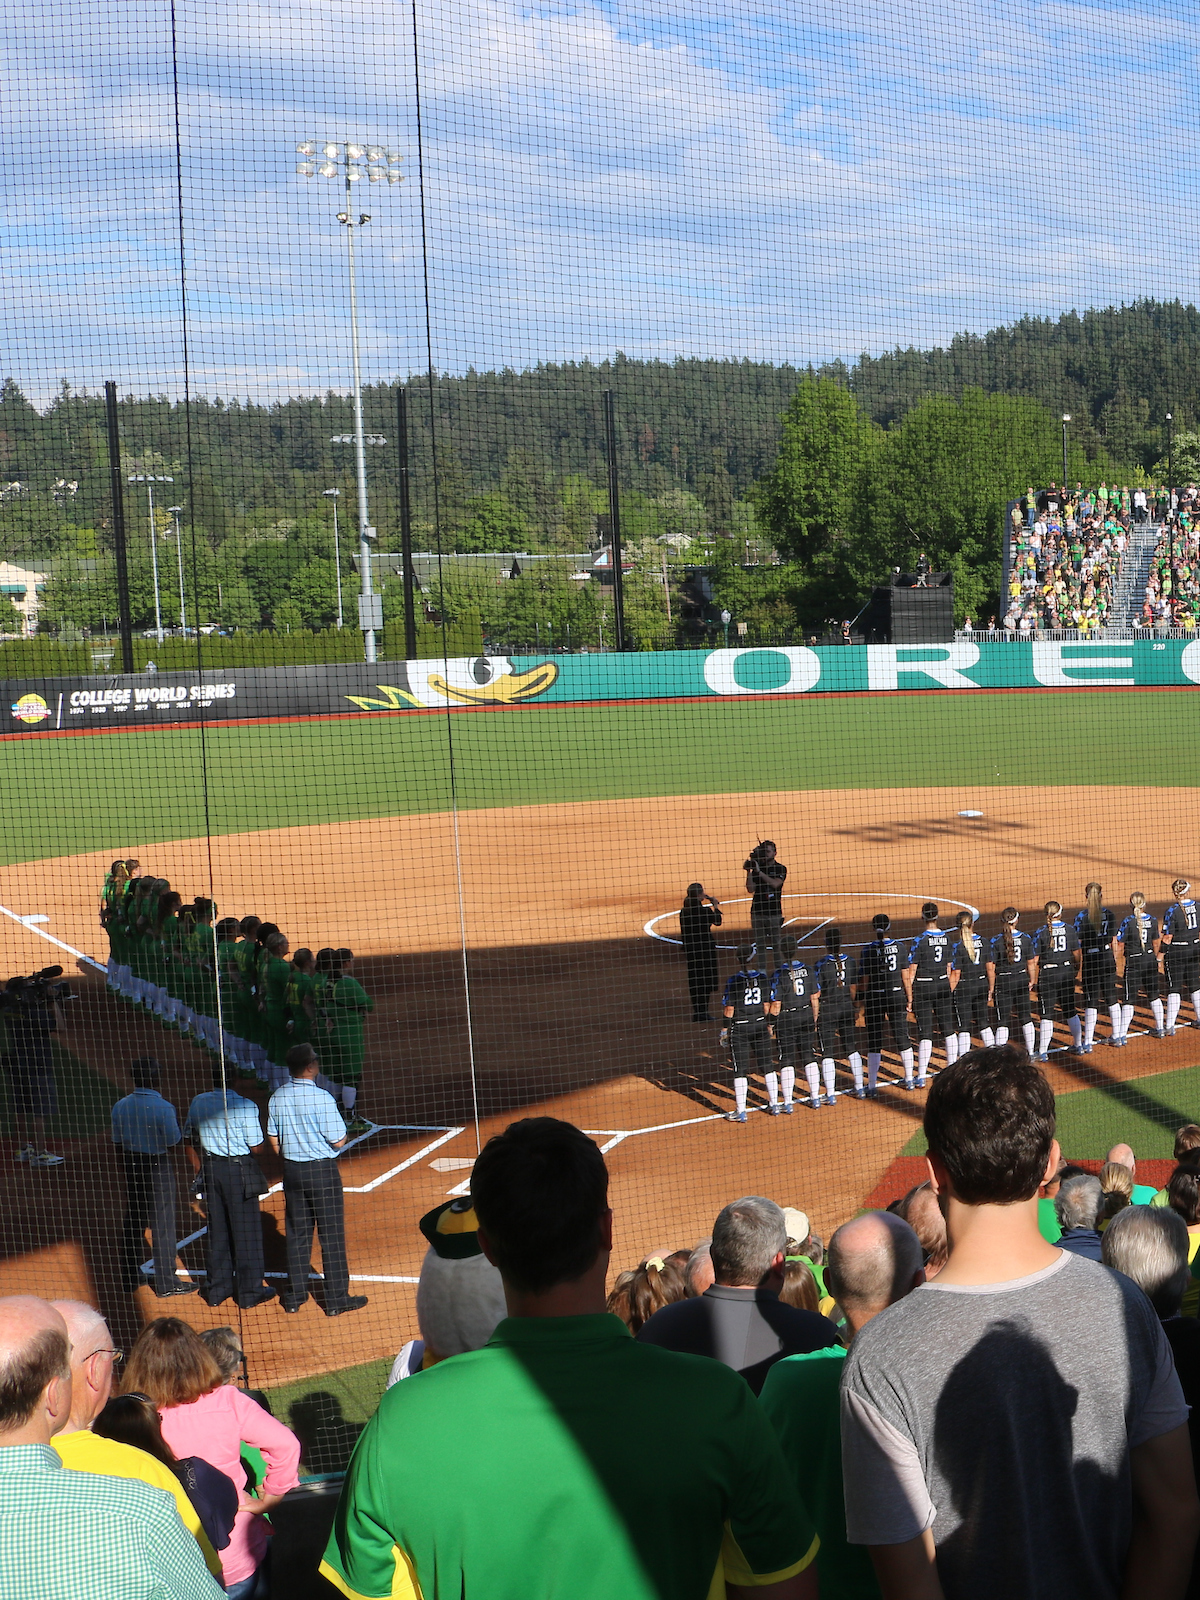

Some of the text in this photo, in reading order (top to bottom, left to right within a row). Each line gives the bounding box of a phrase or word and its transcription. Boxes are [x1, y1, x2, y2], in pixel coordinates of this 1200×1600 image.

[1152, 643, 1166, 651] 220
[70, 683, 236, 707] COLLEGE WORLD SERIES
[1187, 913, 1198, 929] 11
[1053, 936, 1067, 952] 19
[934, 946, 943, 962] 3
[795, 979, 805, 996] 6
[744, 987, 761, 1006] 23
